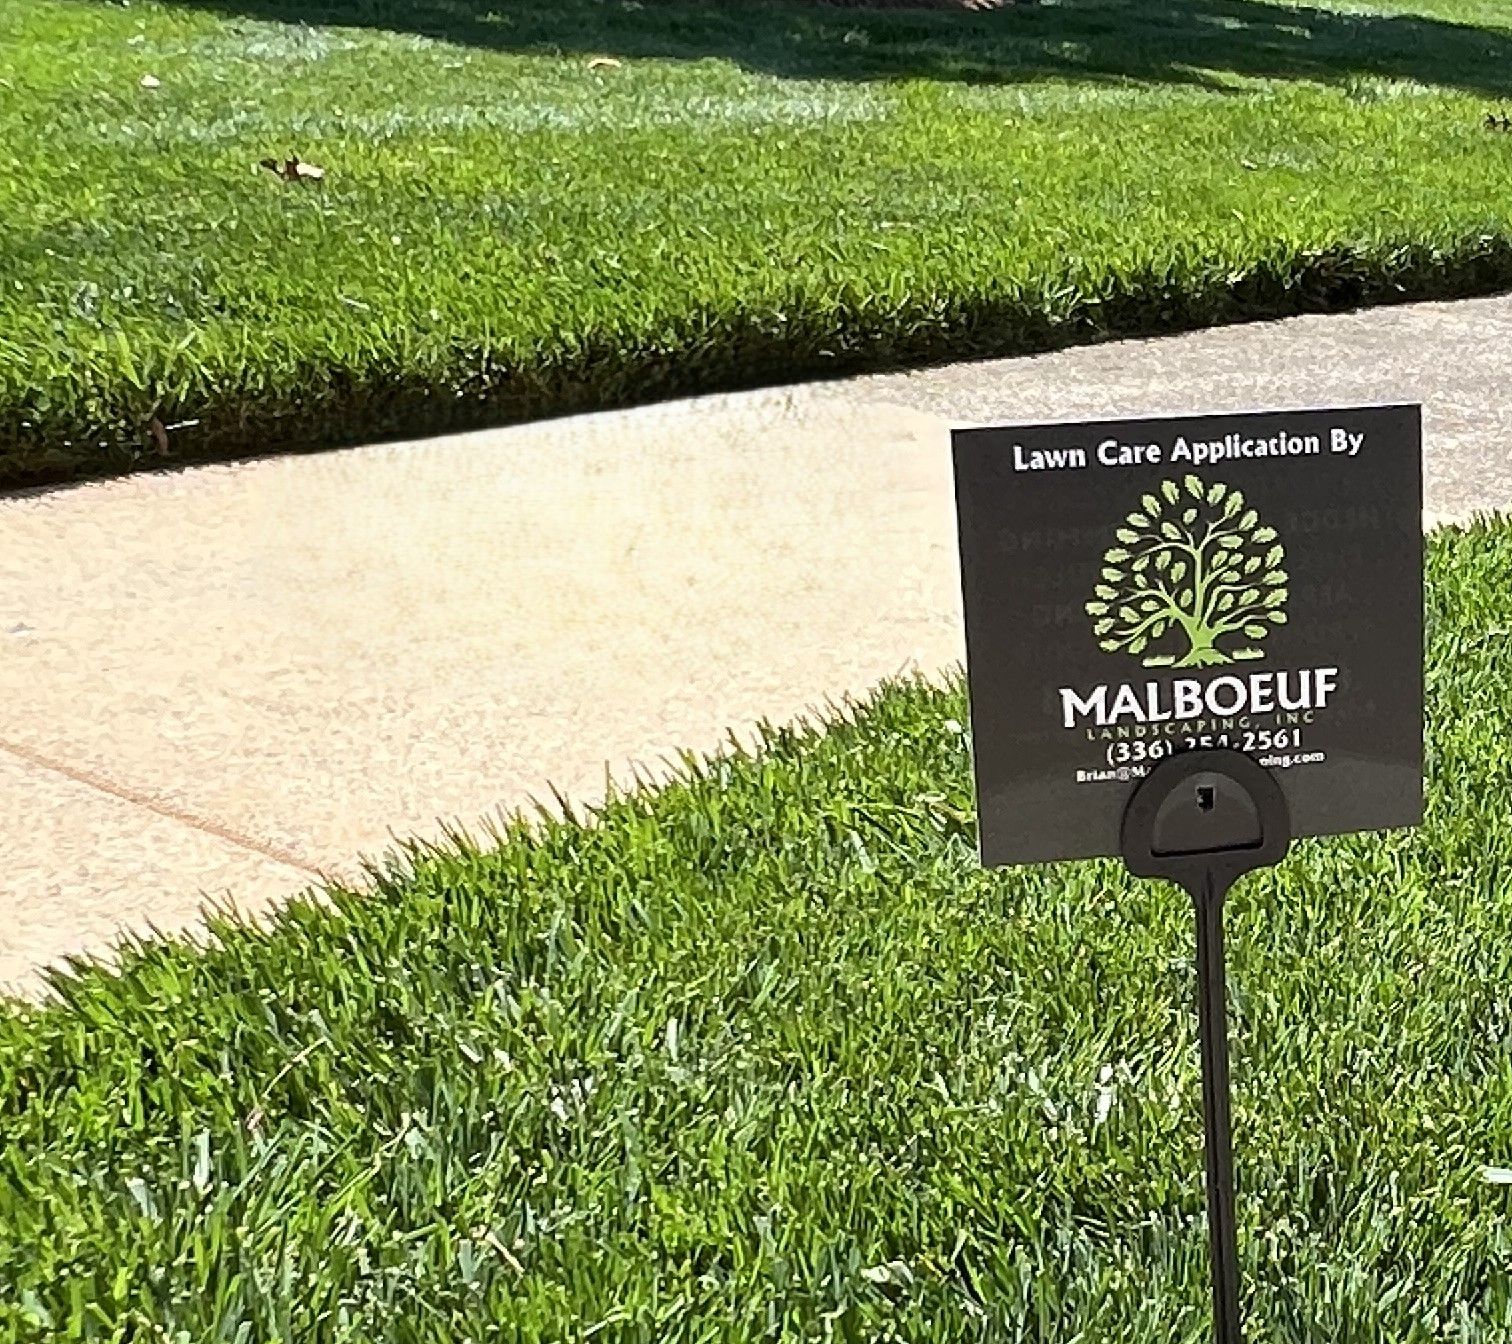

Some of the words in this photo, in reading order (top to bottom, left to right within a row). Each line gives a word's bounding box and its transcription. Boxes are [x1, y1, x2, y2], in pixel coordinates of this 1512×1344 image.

[1013, 444, 1086, 471] Lawn
[1097, 440, 1161, 465] Care
[1171, 431, 1320, 465] Application
[1330, 428, 1364, 456] By
[1058, 668, 1338, 728] MALBOEUF
[1086, 715, 1261, 741] LANDSCAPING,
[1276, 710, 1315, 725] INC
[1106, 739, 1173, 765] (336)
